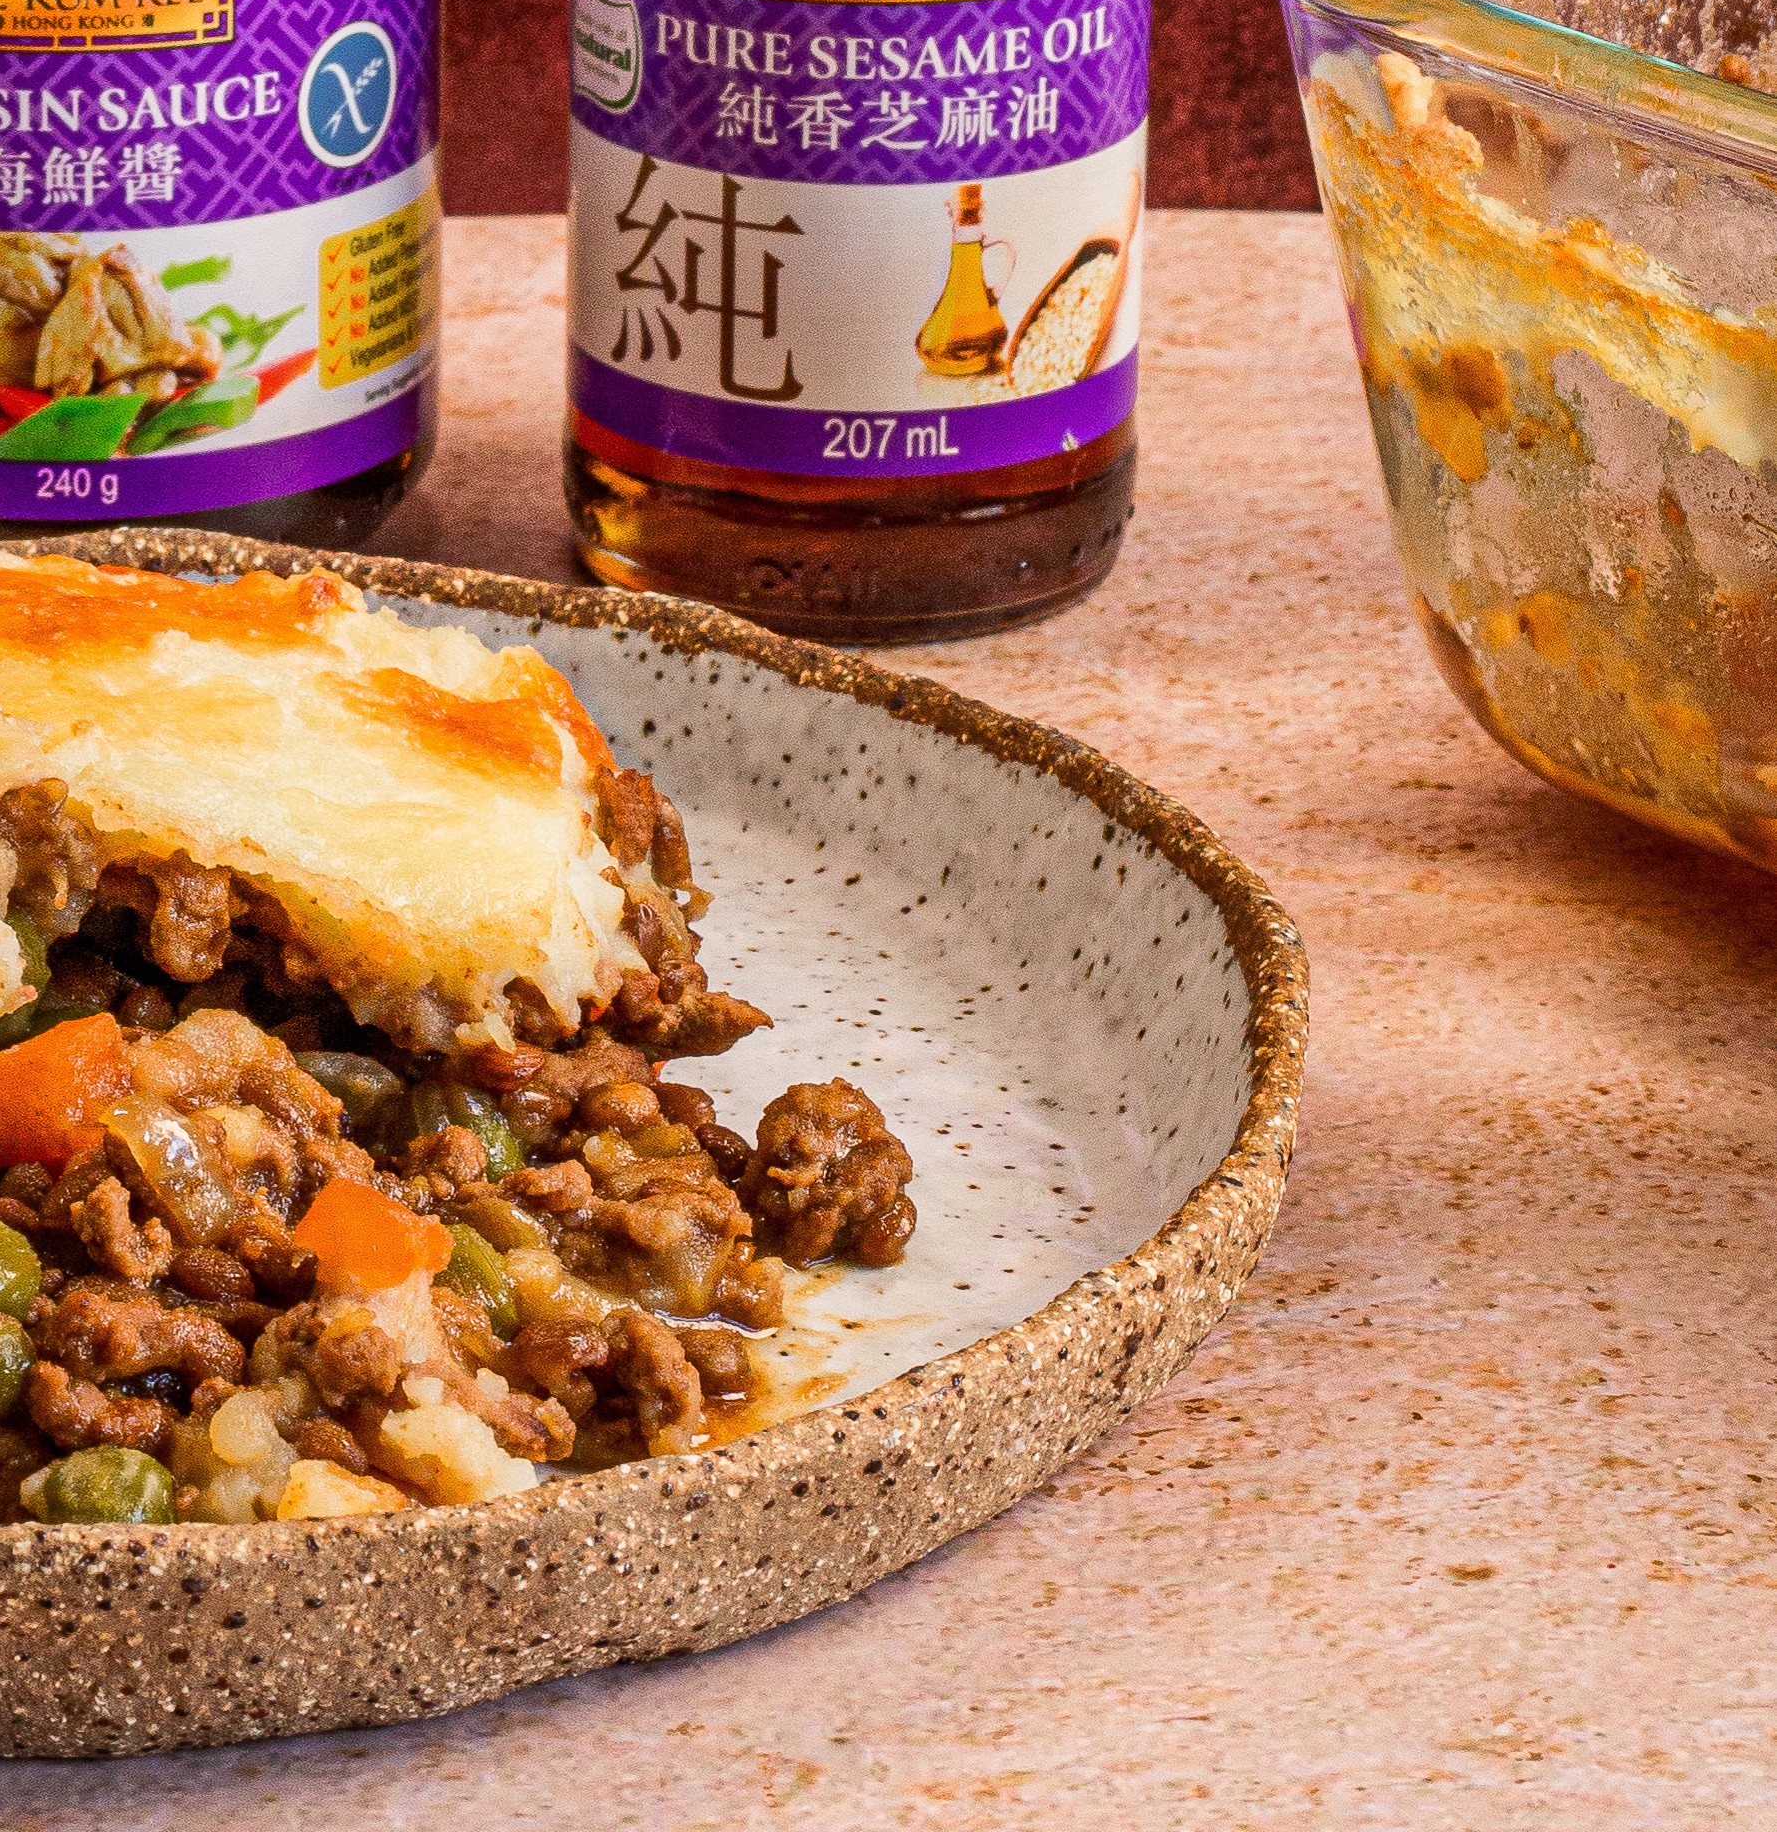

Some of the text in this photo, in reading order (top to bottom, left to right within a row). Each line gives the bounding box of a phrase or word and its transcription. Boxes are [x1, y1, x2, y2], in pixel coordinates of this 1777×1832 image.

[11, 15, 72, 30] HONG
[78, 14, 134, 30] KONG
[657, 12, 793, 75] PURE
[808, 27, 1031, 81] SESAME
[1042, 5, 1113, 64] OIL
[97, 71, 282, 133] SAUCE
[715, 77, 1059, 152] 純香芝麻油
[613, 154, 804, 402] 純
[822, 416, 960, 460] 207 mL
[35, 468, 119, 505] 240 g
